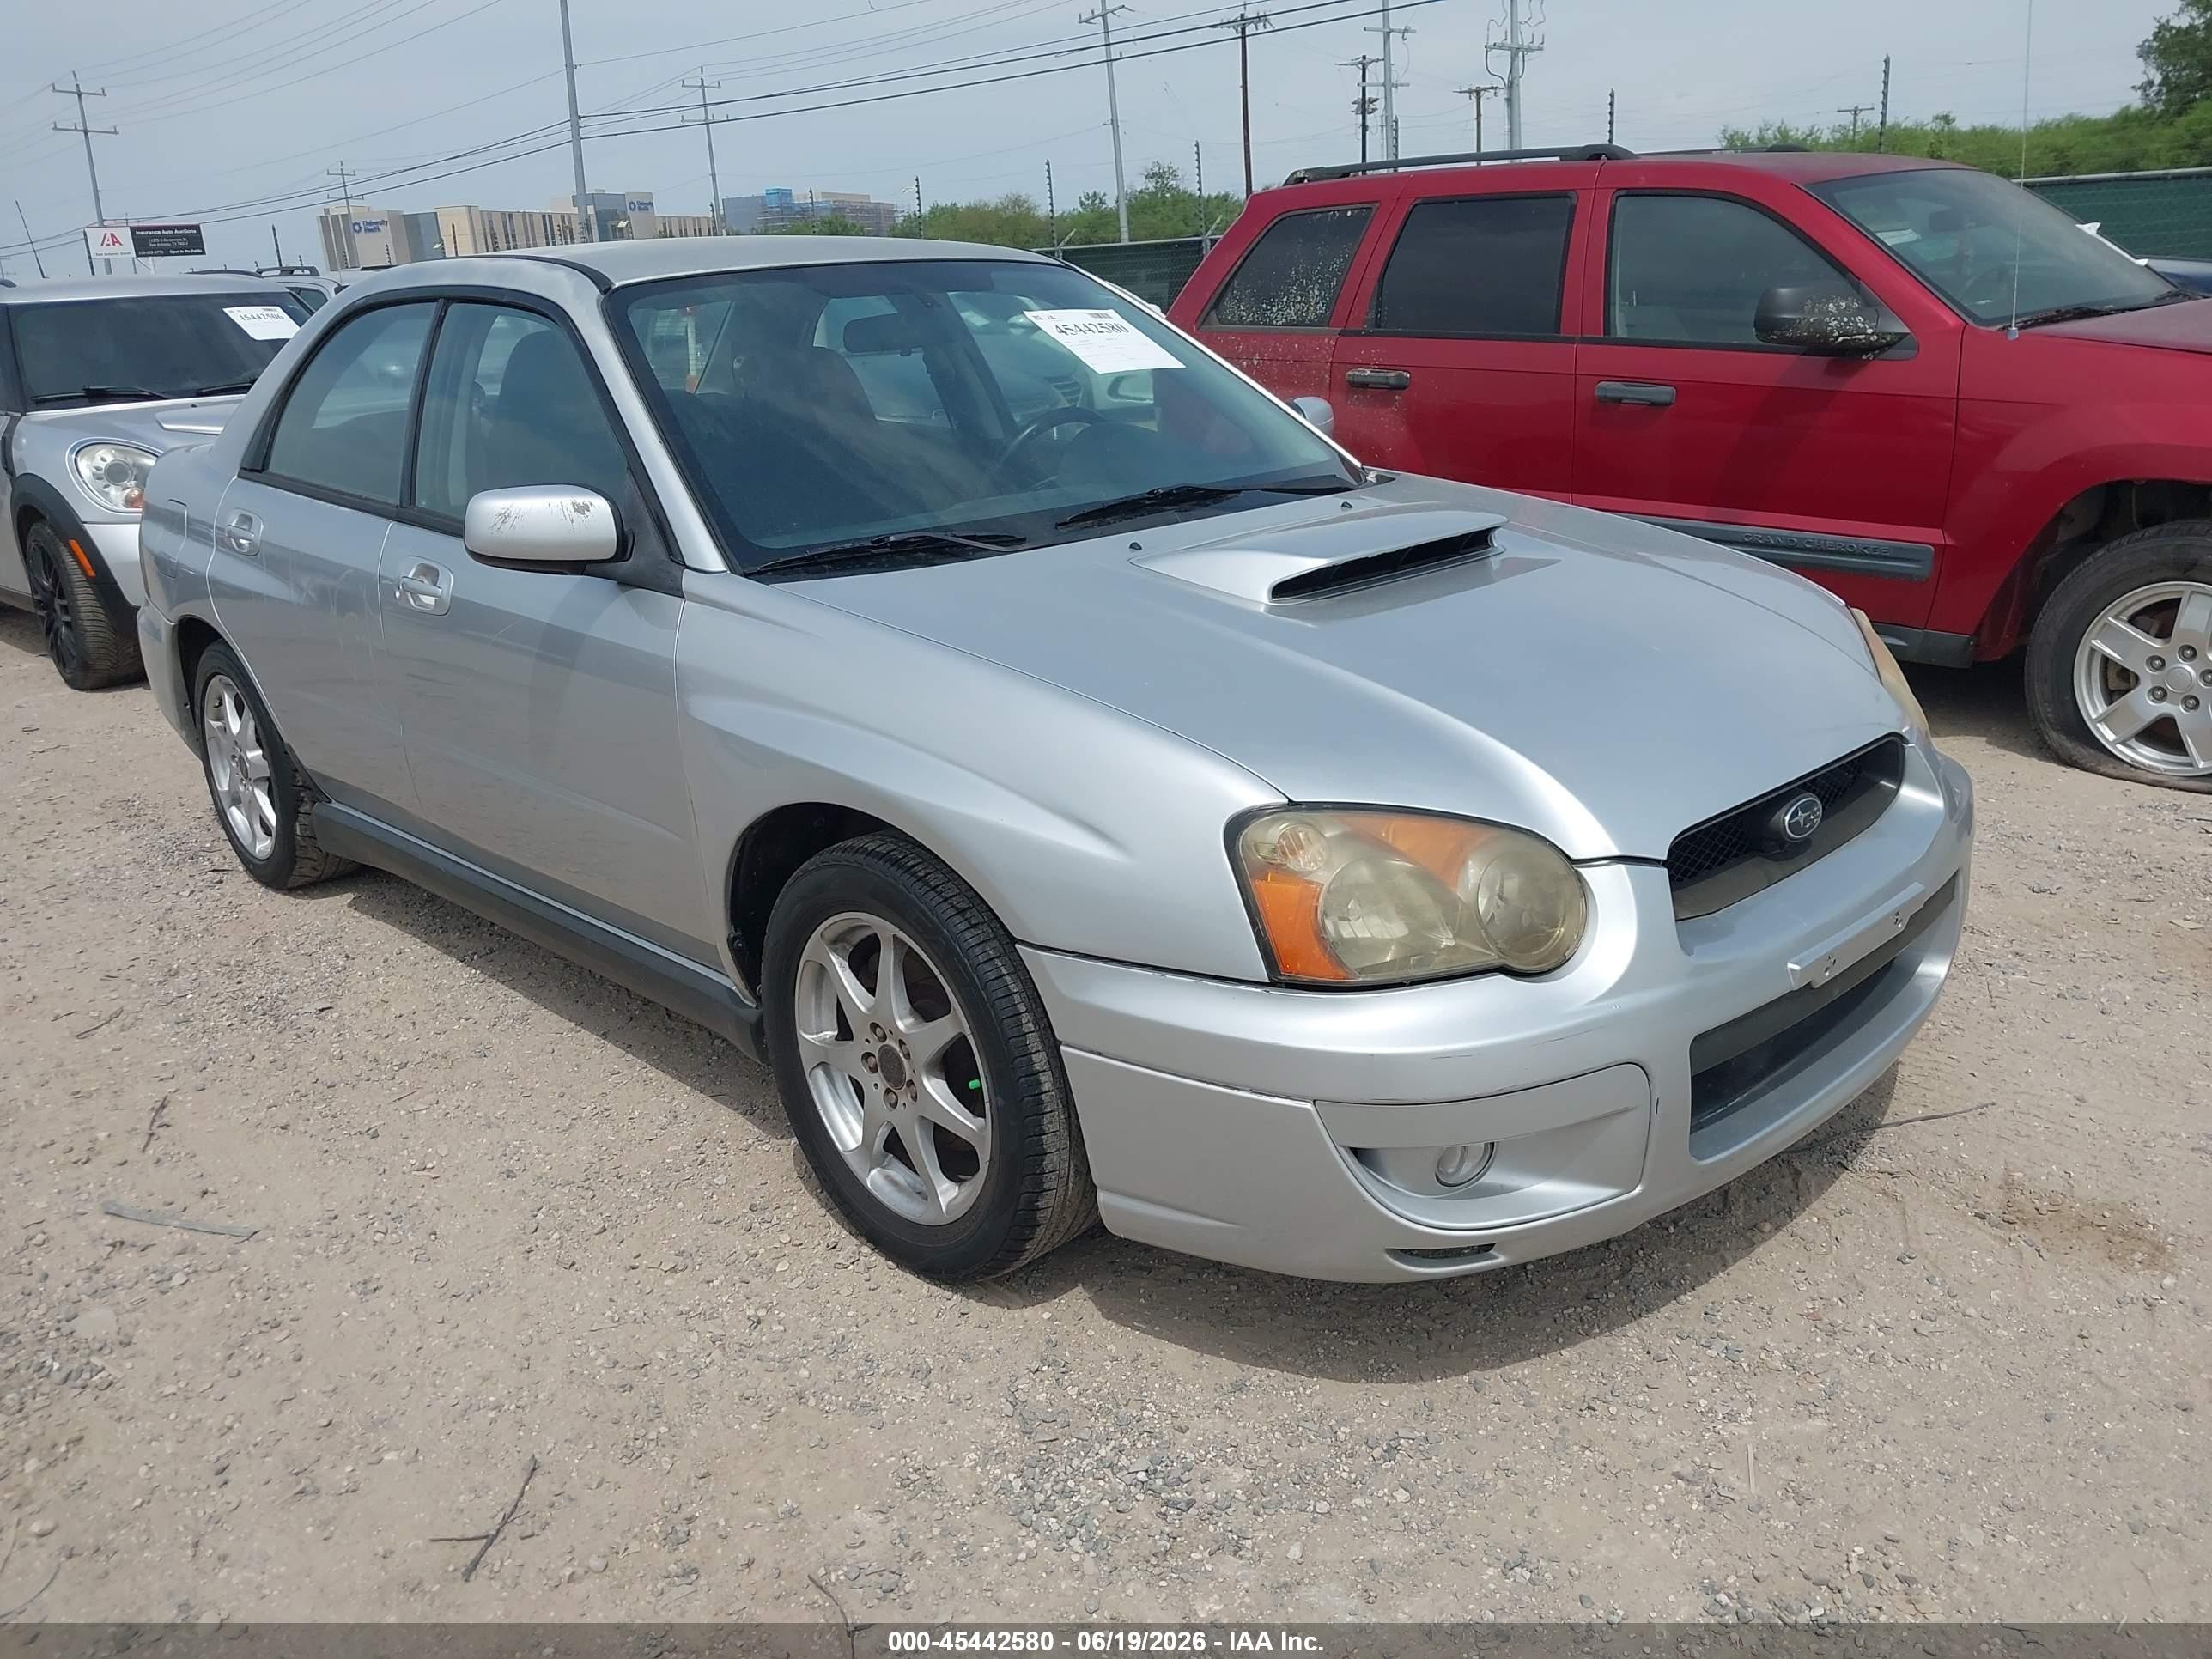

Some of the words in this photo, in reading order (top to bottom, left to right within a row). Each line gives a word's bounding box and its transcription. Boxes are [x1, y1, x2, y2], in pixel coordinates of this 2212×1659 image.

[1054, 322, 1130, 336] 45442580
[1742, 532, 1797, 546] GRAND
[1803, 538, 1890, 556] CHEROKEE
